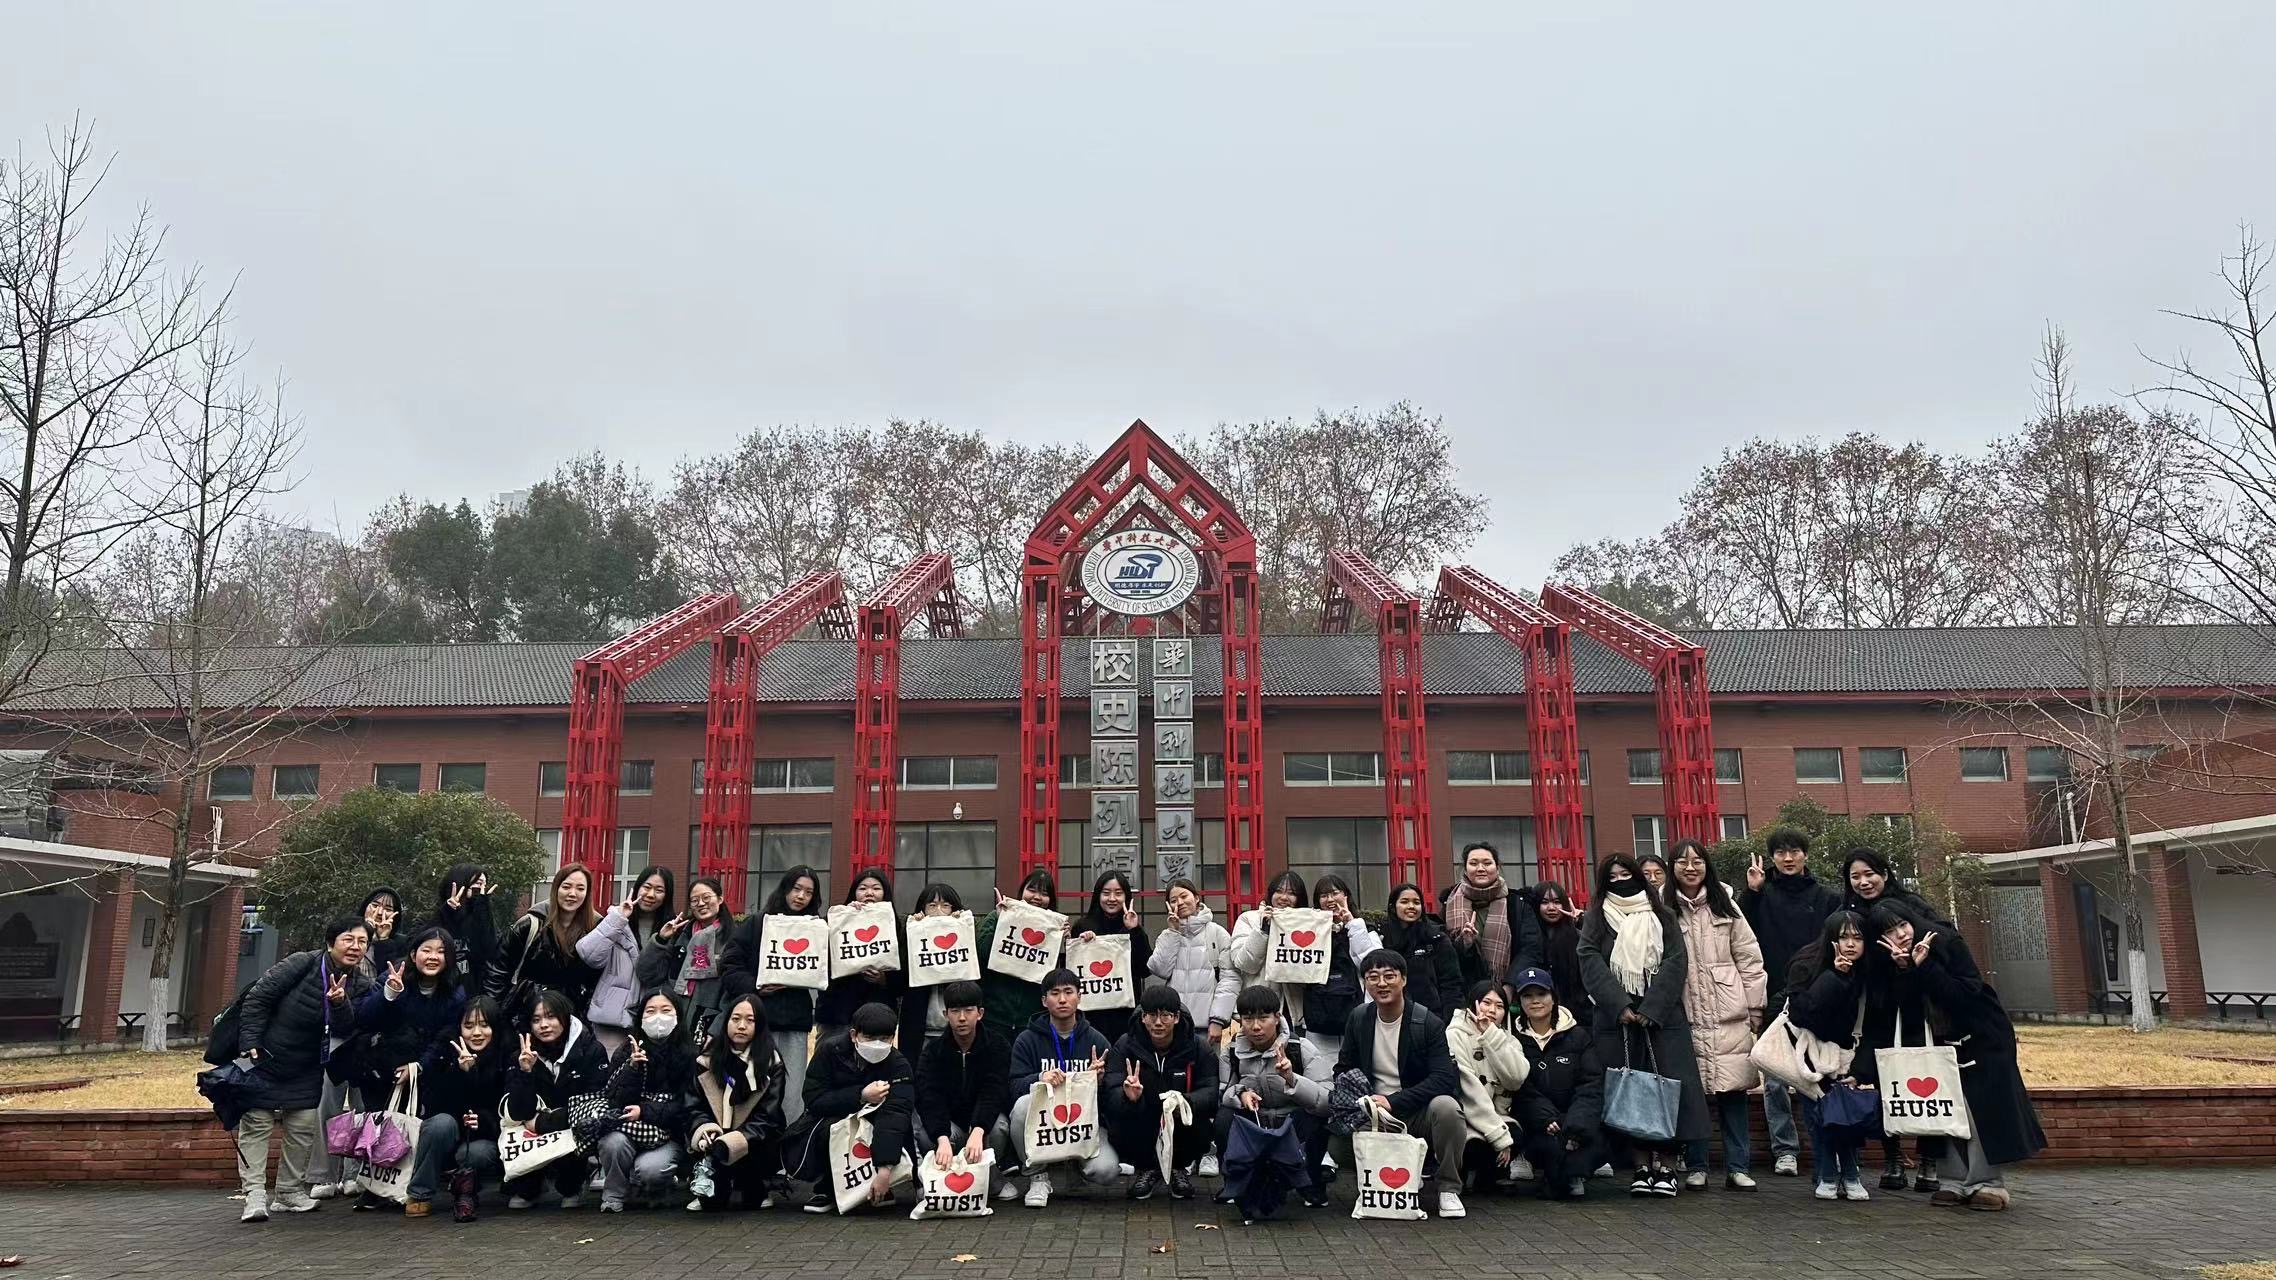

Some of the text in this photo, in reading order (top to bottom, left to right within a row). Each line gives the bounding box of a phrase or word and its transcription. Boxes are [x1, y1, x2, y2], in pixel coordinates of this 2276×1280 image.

[1091, 585, 1130, 611] UNIVERSITY
[1132, 602, 1141, 613] OF
[1142, 596, 1171, 613] SCIENCE
[1167, 590, 1185, 606] AND
[1177, 549, 1197, 593] TECHNOLOGY
[841, 930, 850, 945] I
[1006, 925, 1018, 941] I
[1278, 932, 1287, 948] I
[770, 939, 779, 954] I
[839, 938, 891, 960] HUST
[920, 938, 929, 952] I
[998, 939, 1049, 965] HUST
[765, 955, 820, 971] HUST
[918, 947, 970, 968] HUST
[1274, 948, 1325, 965] HUST
[1077, 965, 1085, 979] I
[1080, 977, 1124, 995] HUST
[1891, 1080, 1901, 1098] I
[1888, 1099, 1954, 1118] HUST
[1038, 1109, 1048, 1127] I
[507, 1131, 517, 1144] I
[1036, 1124, 1093, 1147] HUST
[843, 1152, 851, 1171] I
[928, 1179, 938, 1194] I
[1363, 1169, 1373, 1187] I
[922, 1194, 985, 1213] HUST
[1361, 1189, 1419, 1211] HUST
